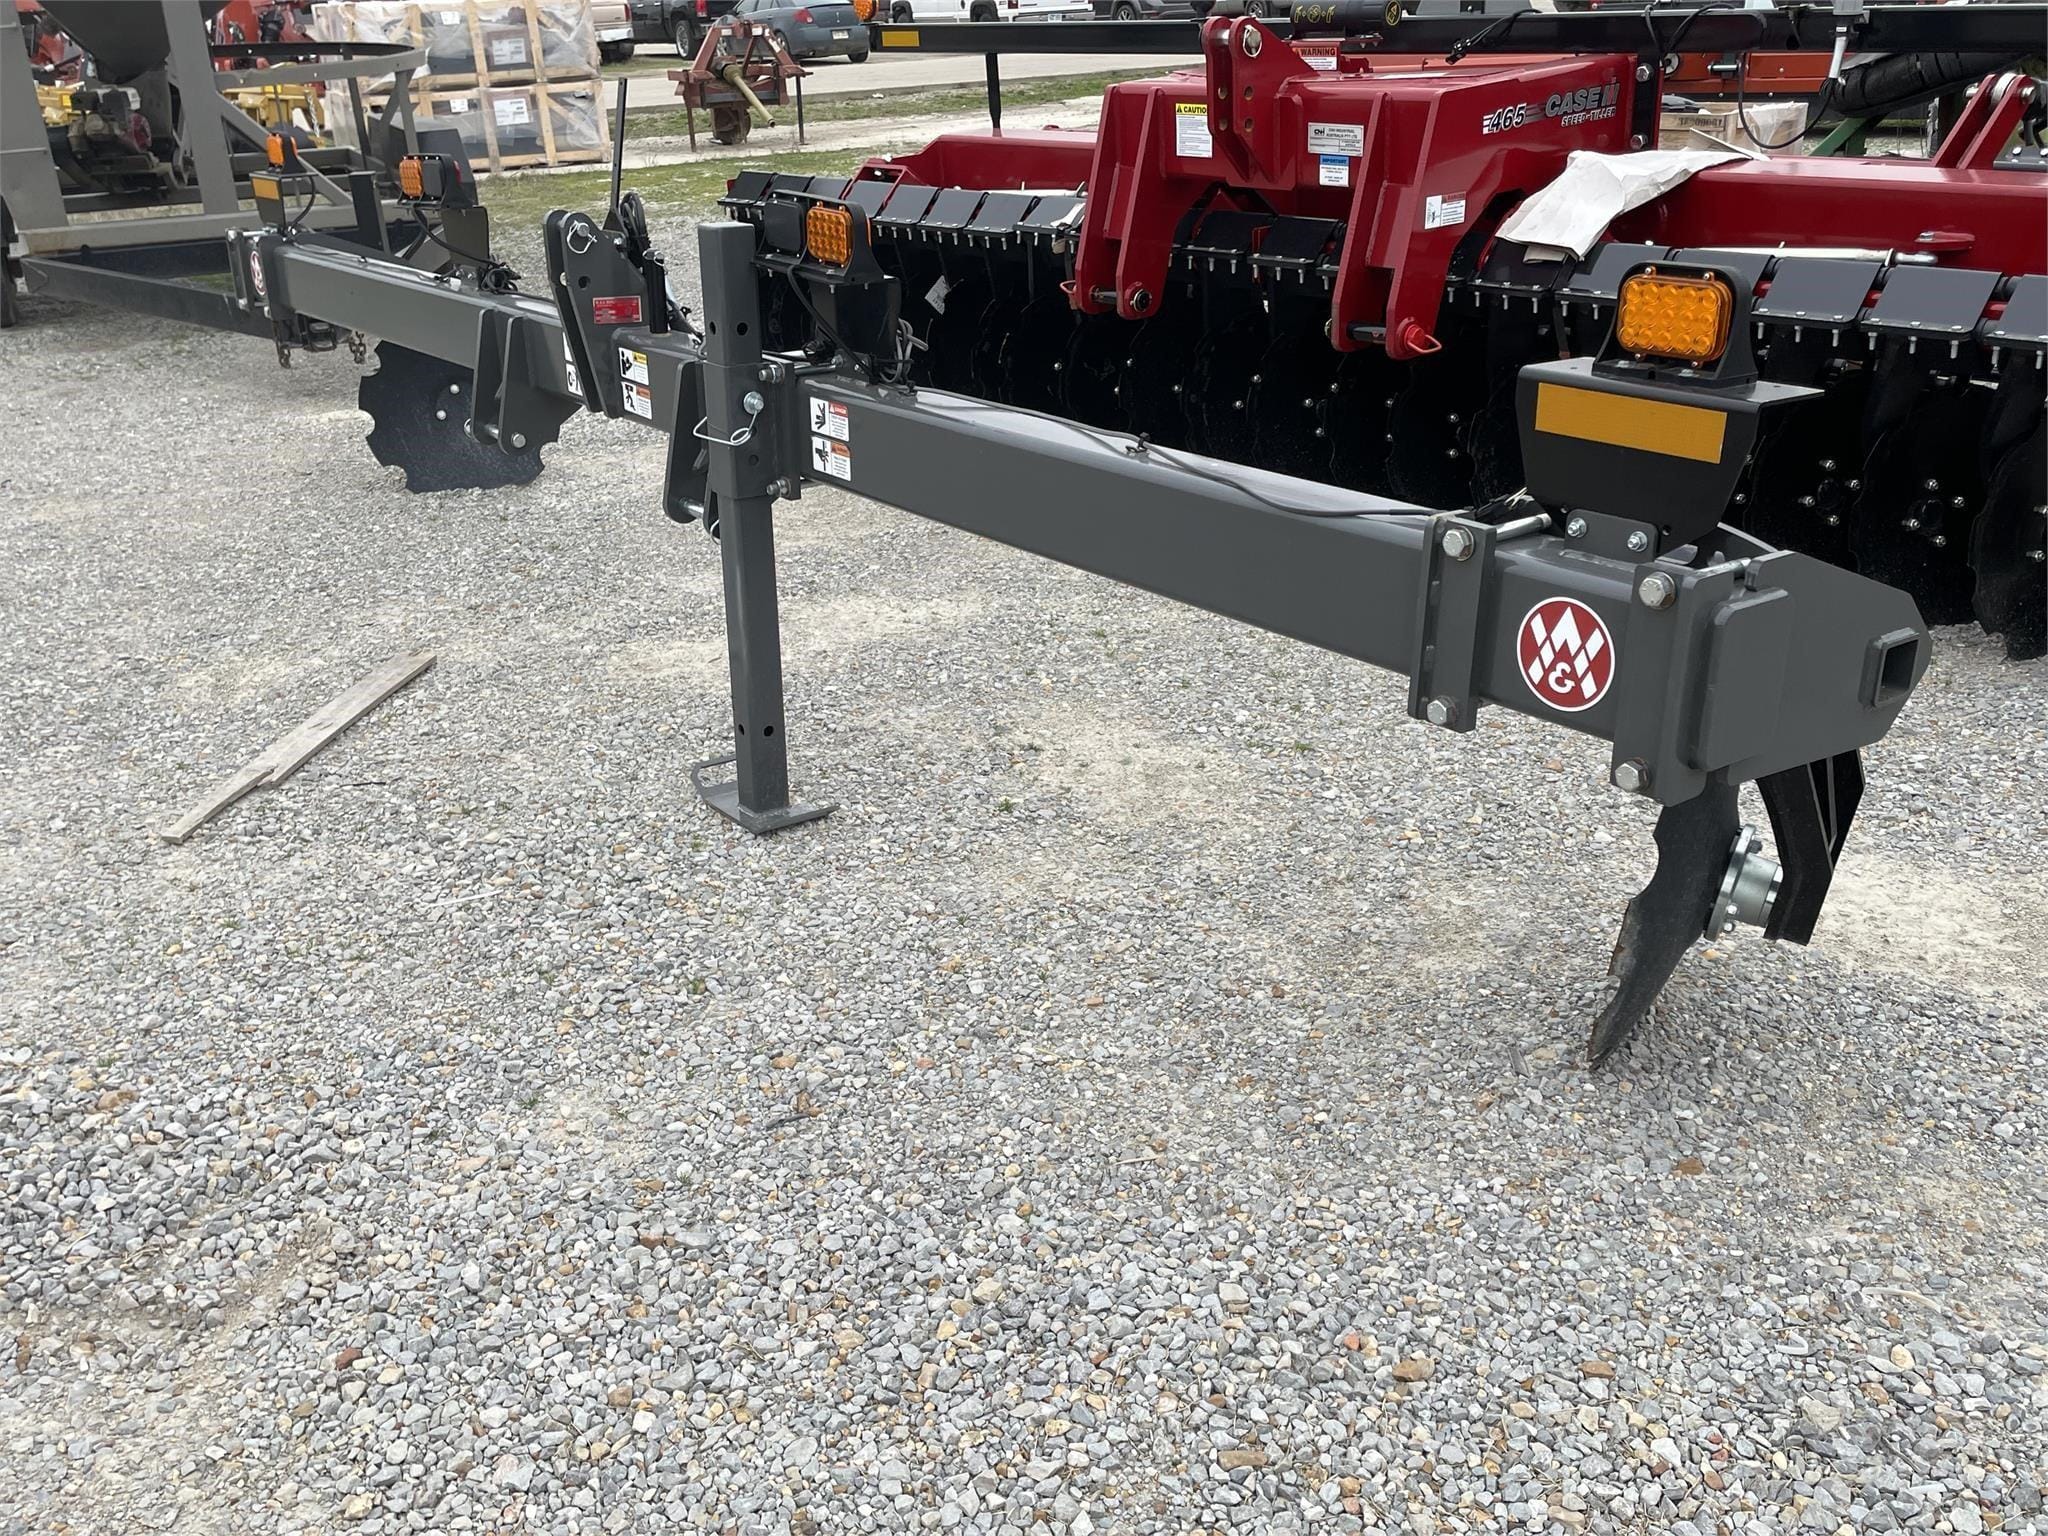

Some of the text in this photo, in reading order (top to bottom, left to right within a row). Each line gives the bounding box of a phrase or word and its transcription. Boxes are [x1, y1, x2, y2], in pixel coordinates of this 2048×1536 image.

[1301, 47, 1336, 56] WARNING
[1183, 106, 1207, 114] CAUTIO
[1545, 87, 1600, 118] CASE
[1489, 102, 1528, 134] 465
[1560, 106, 1617, 127] SPEED-TILLER
